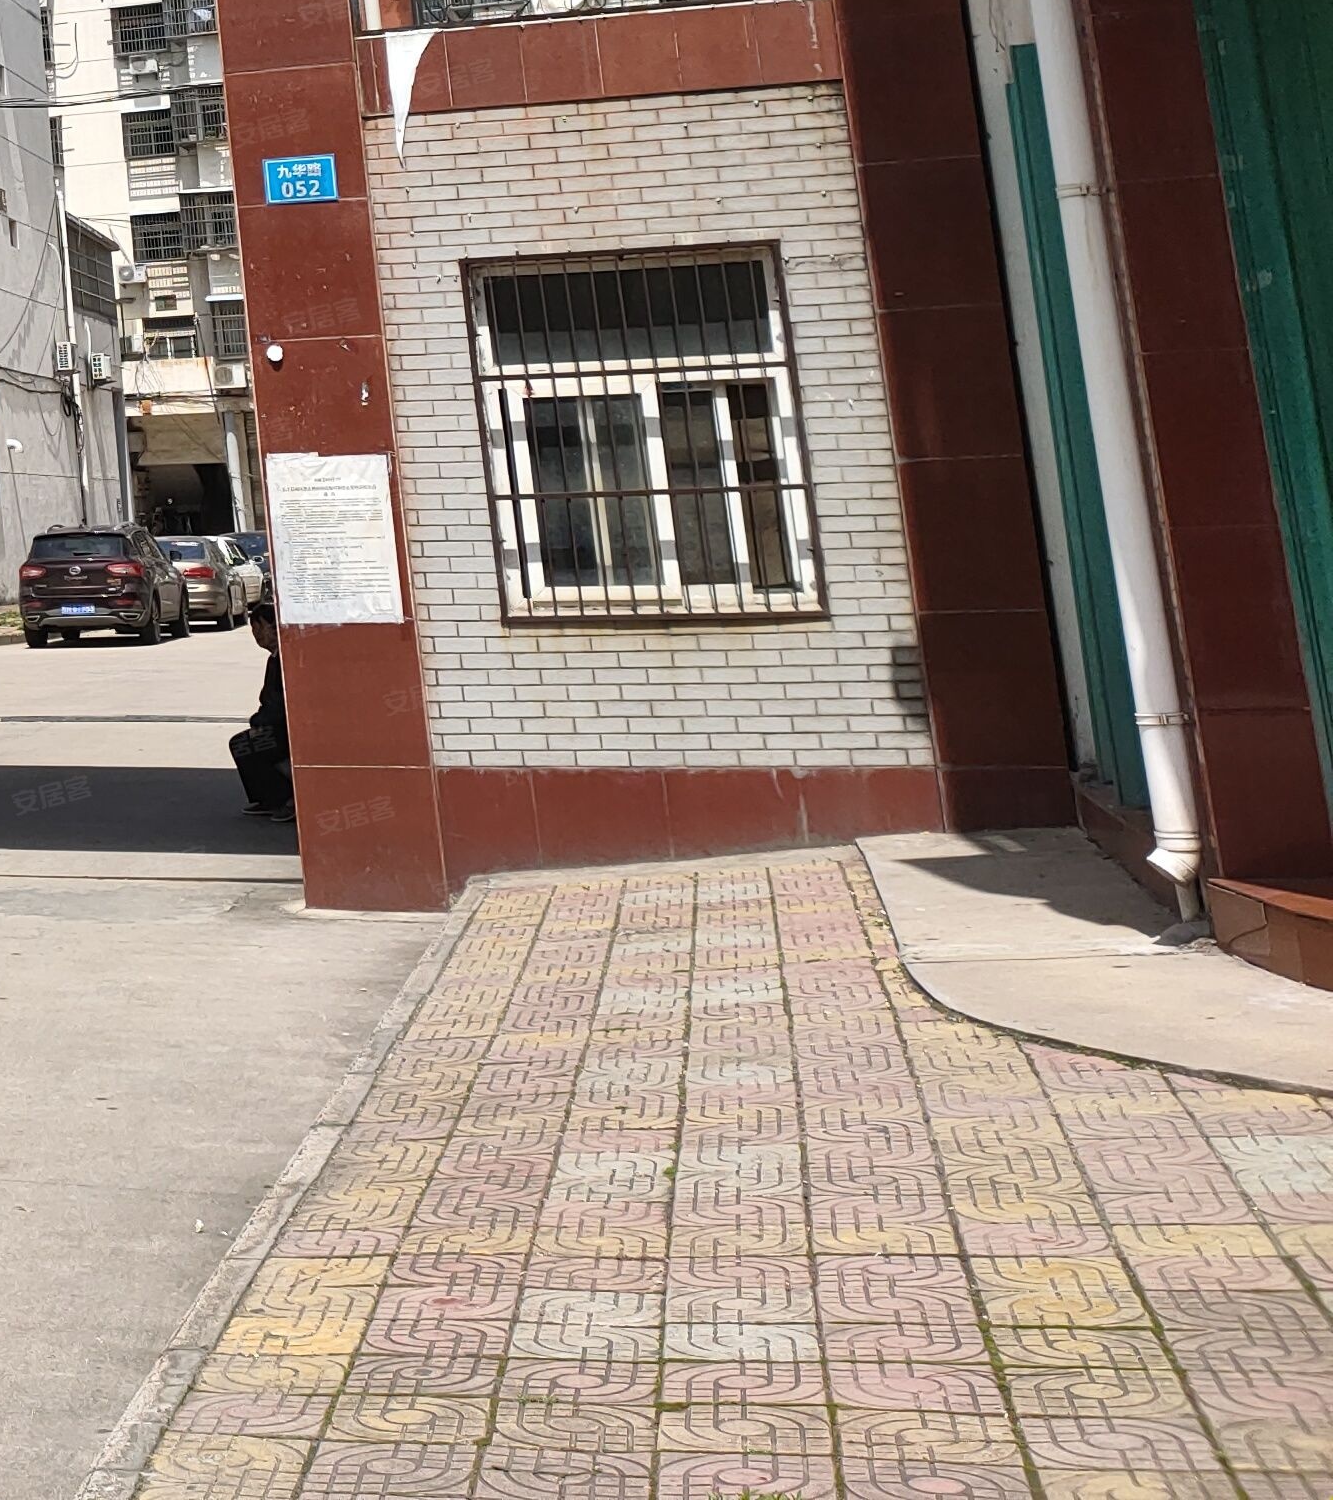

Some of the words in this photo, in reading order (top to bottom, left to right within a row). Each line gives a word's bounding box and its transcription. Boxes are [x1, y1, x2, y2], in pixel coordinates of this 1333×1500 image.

[276, 162, 322, 179] 九华路
[281, 180, 321, 198] 052
